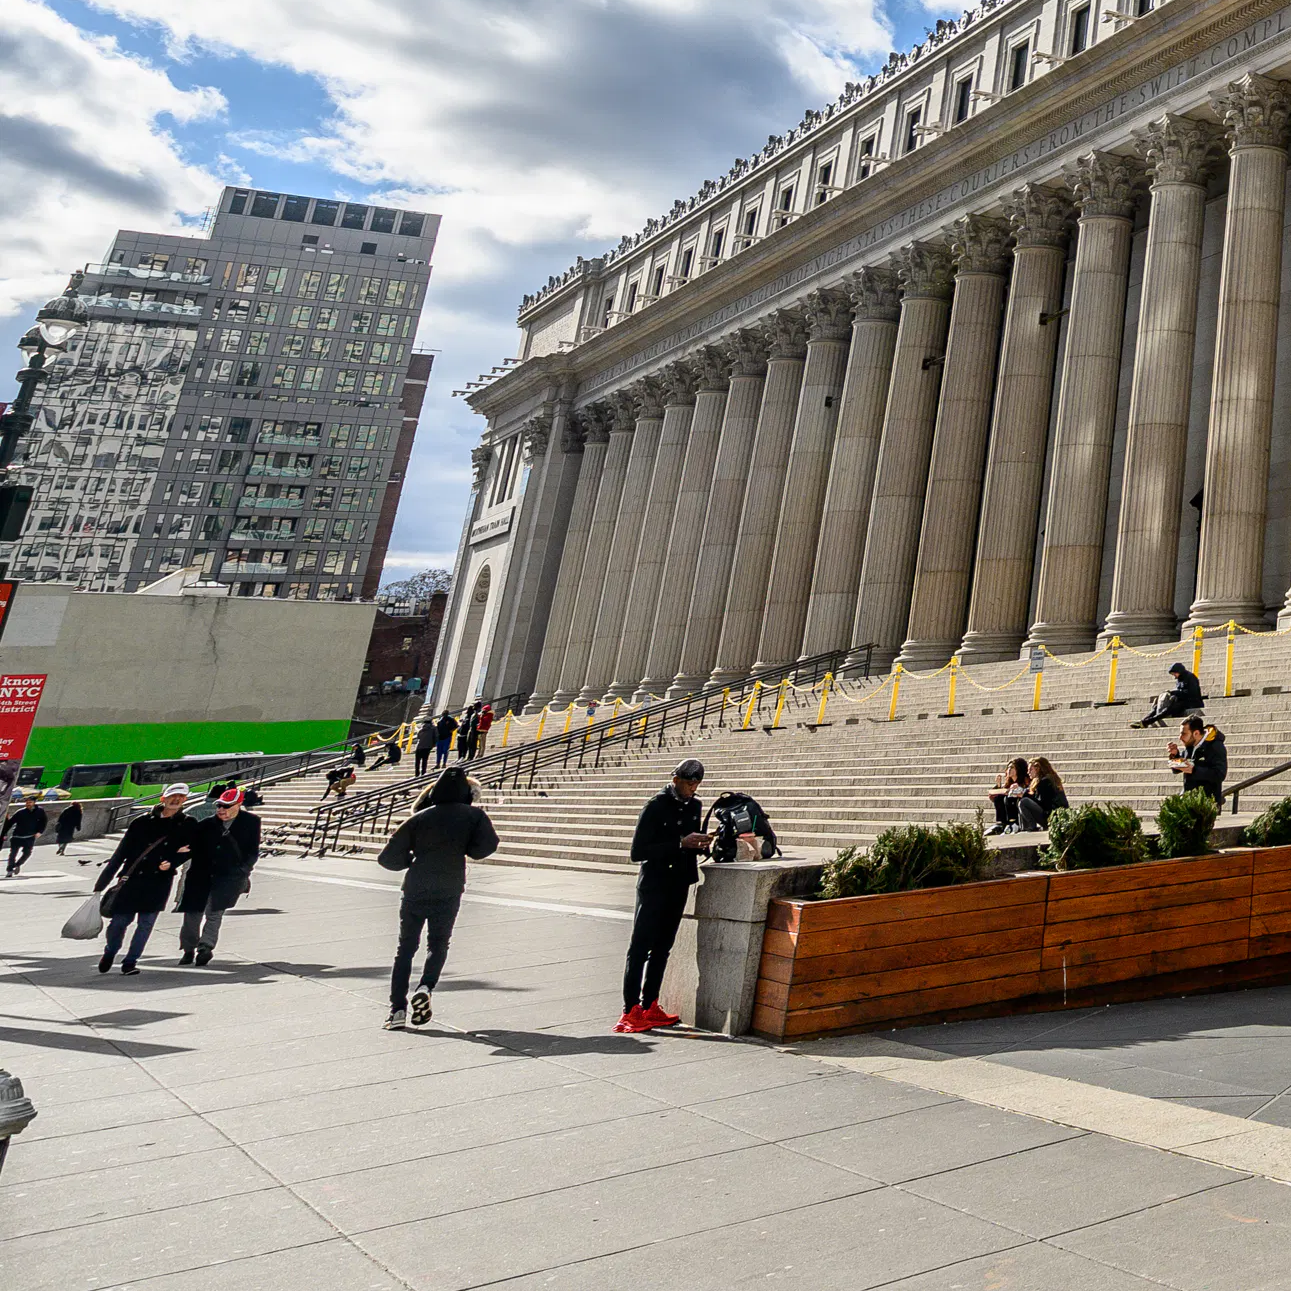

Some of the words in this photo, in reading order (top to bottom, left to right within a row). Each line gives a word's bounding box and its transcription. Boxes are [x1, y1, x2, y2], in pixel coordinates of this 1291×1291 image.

[857, 218, 893, 248] STAYS
[900, 193, 943, 228] THESE
[951, 146, 1031, 202] COURIERS
[1038, 121, 1083, 157] FROM
[1094, 95, 1128, 128] THE
[1139, 58, 1200, 105] SWIFT
[2, 677, 43, 686] know
[0, 686, 41, 698] NYC
[0, 705, 35, 713] istrict
